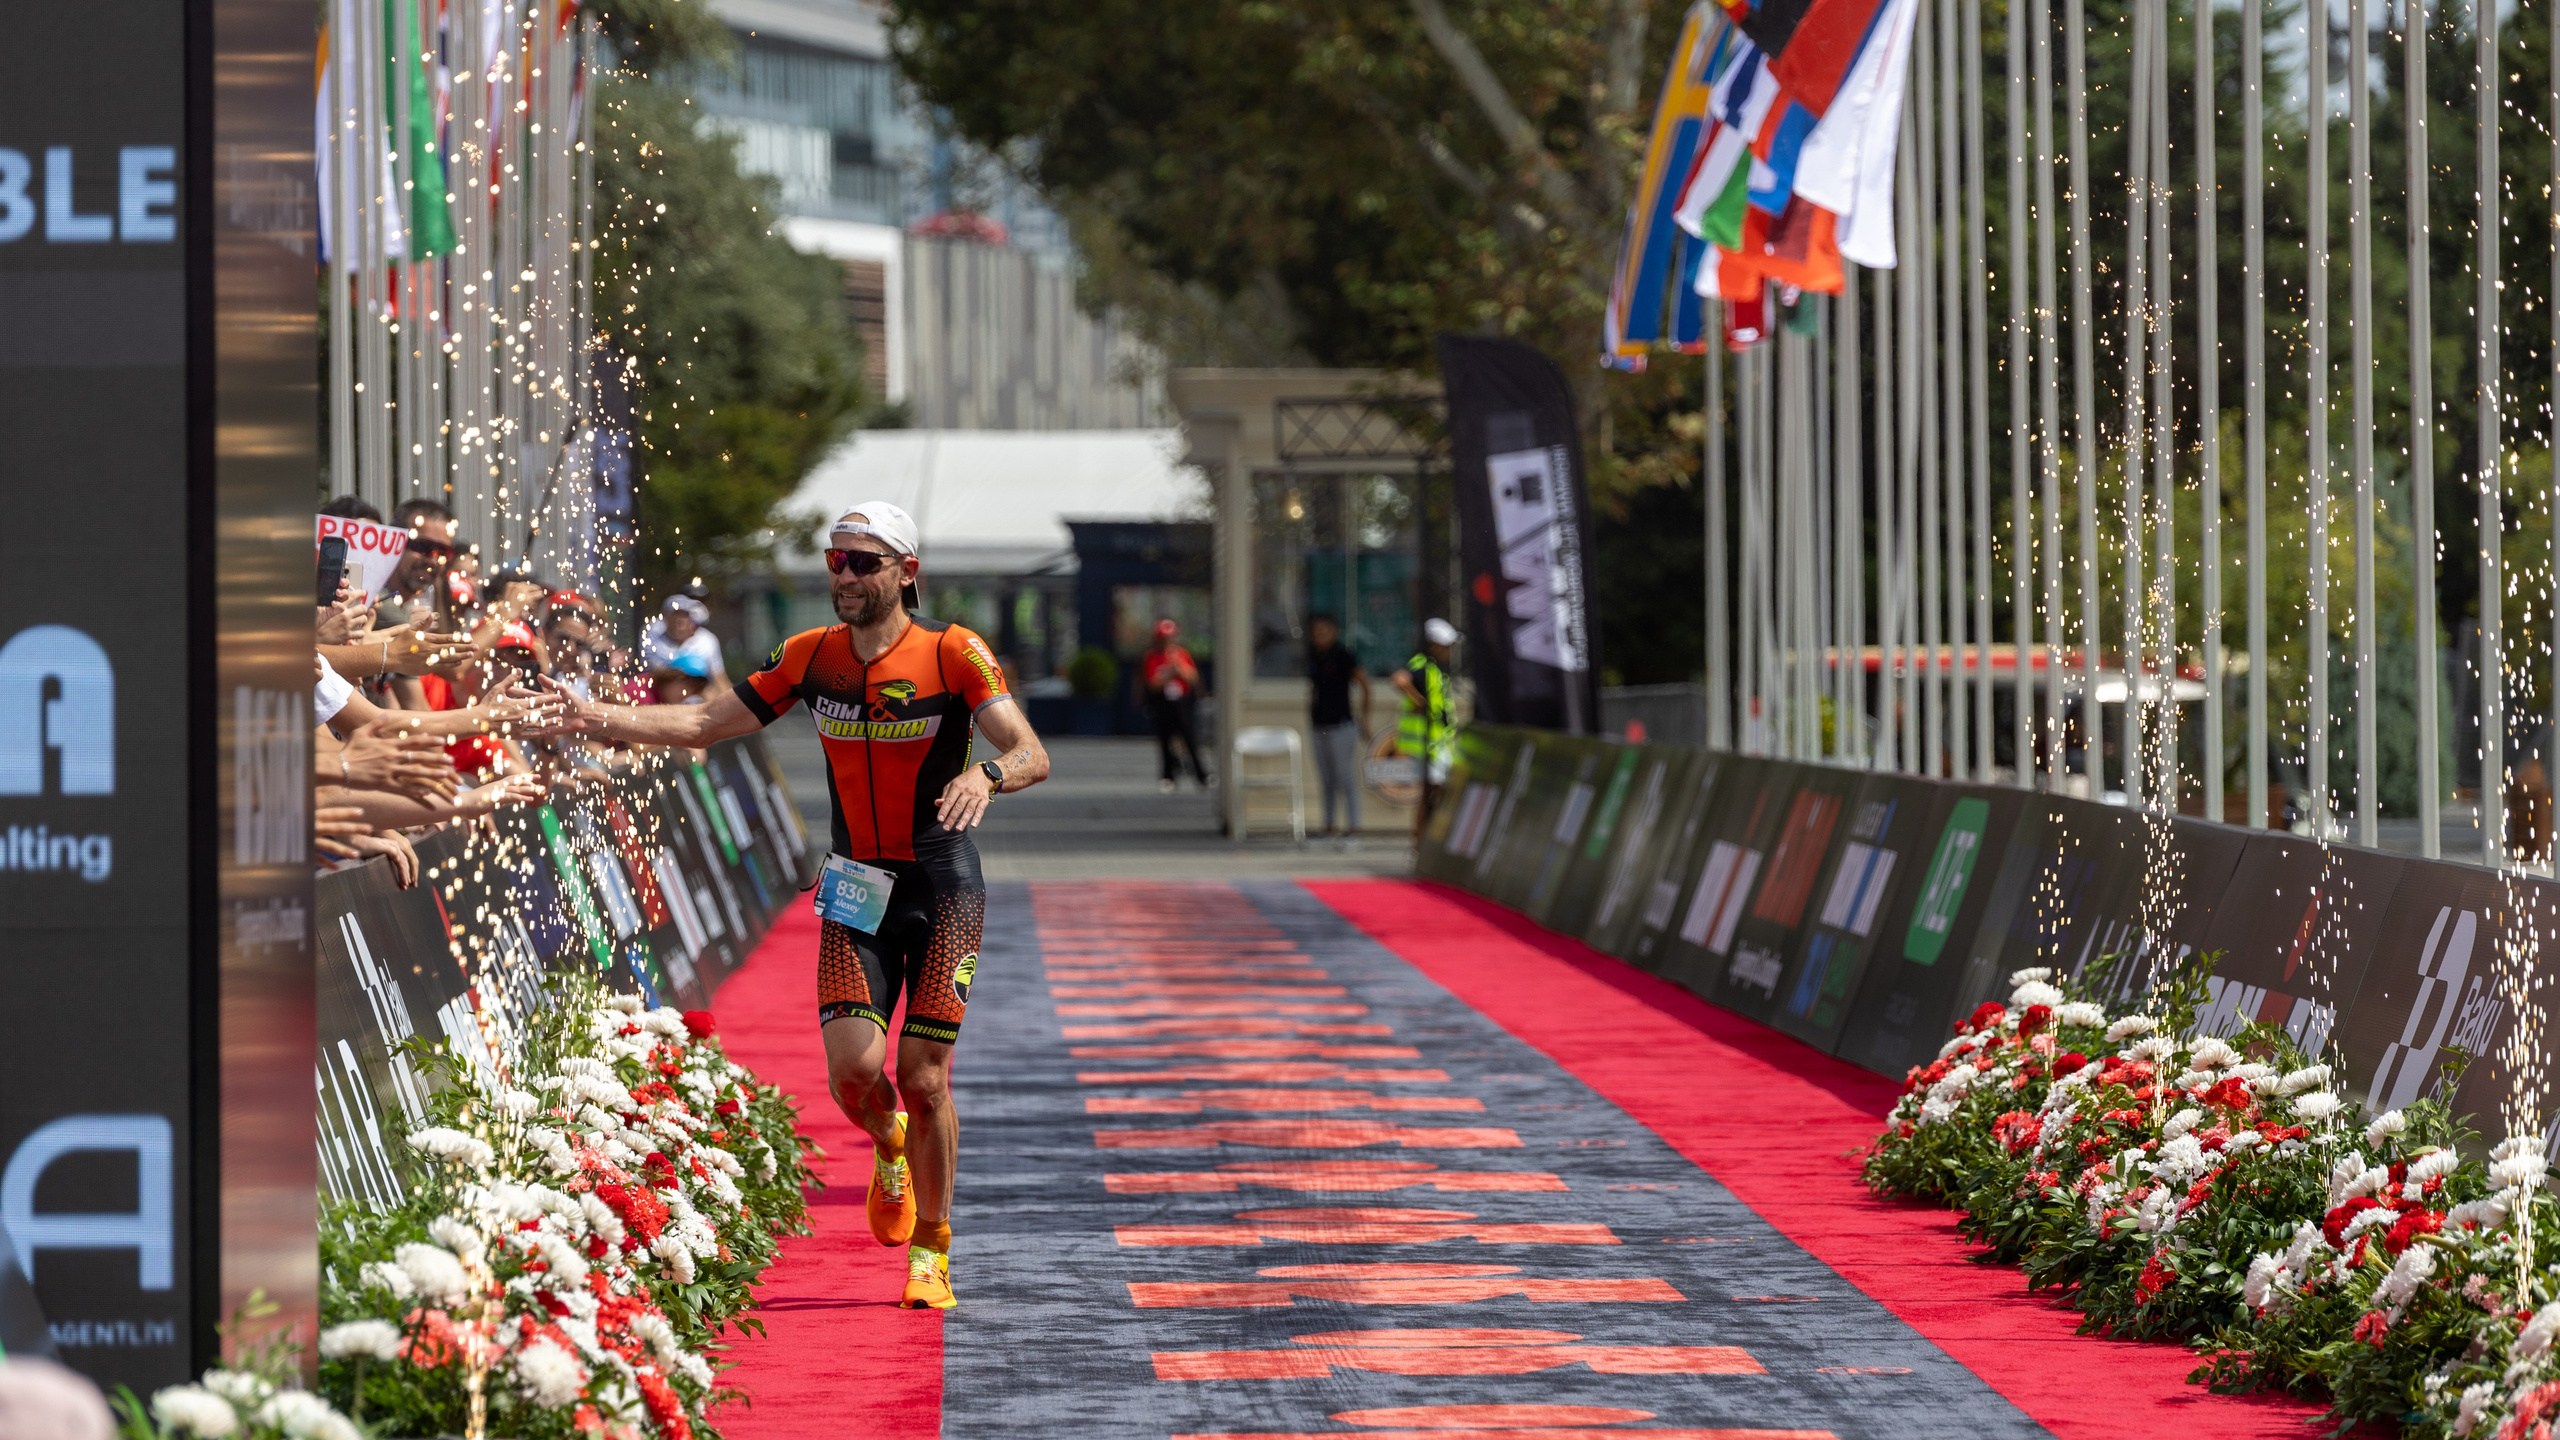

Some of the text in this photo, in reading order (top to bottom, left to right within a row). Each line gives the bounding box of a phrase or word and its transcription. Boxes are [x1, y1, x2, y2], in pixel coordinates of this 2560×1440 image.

[317, 516, 408, 557] PROUD
[833, 898, 860, 914] Alexey
[836, 880, 868, 904] 830
[2448, 973, 2505, 1058] Baku
